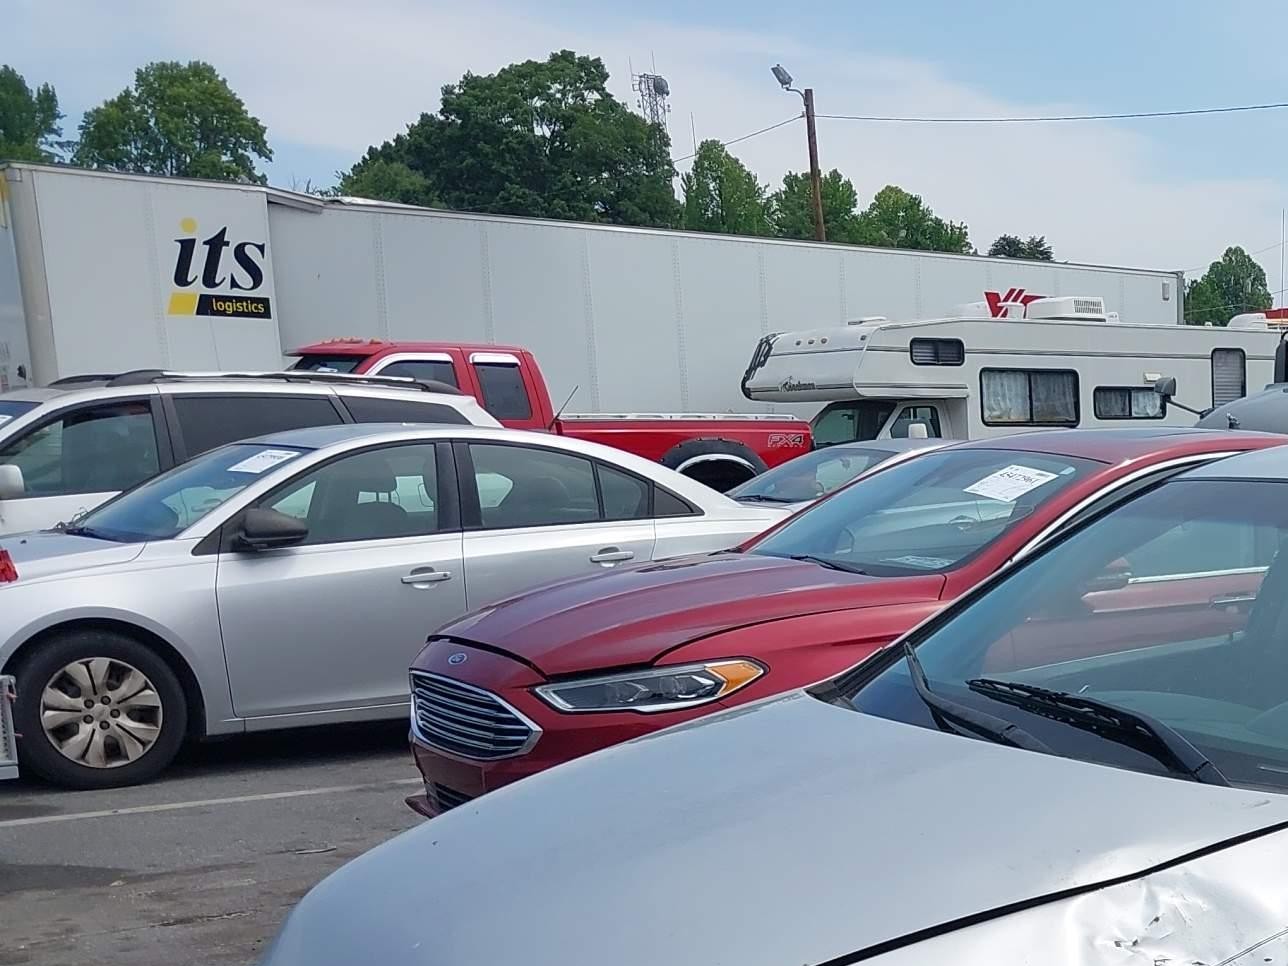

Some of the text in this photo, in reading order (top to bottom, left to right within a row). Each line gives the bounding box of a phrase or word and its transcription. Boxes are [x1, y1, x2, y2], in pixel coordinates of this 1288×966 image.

[173, 217, 265, 291] its
[212, 298, 265, 314] logistics
[768, 434, 803, 446] FX4
